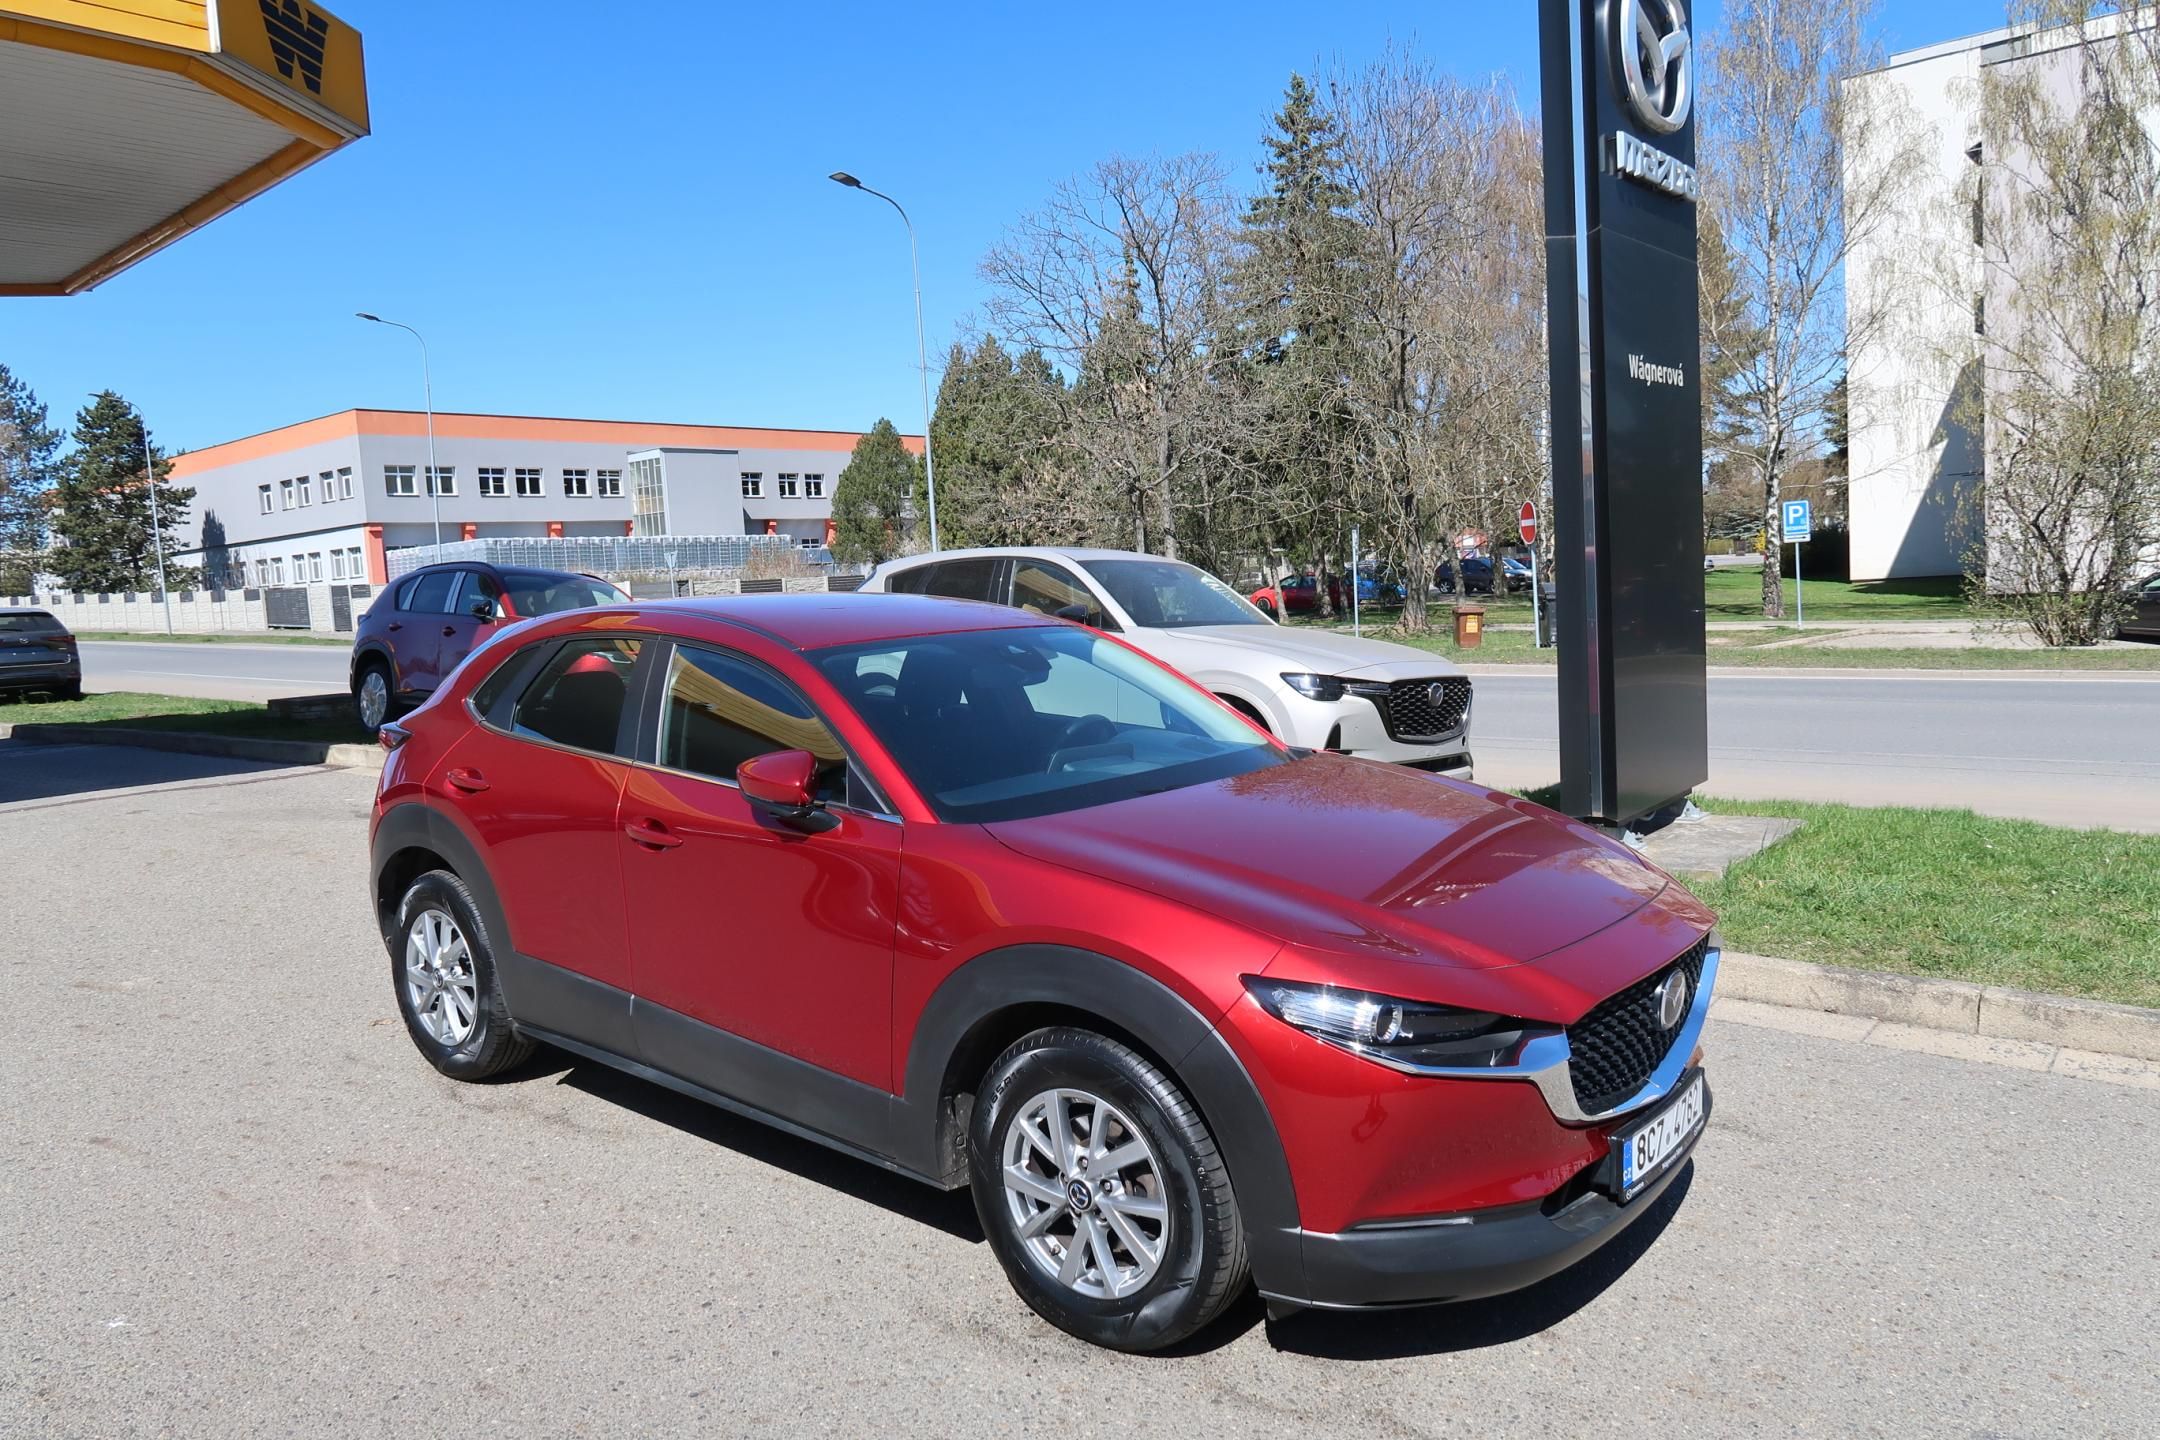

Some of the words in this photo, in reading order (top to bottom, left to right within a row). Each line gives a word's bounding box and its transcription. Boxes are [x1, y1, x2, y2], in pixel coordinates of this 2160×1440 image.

[1628, 353, 1684, 387] Wágnerová
[1788, 505, 1804, 525] P
[1637, 1118, 1664, 1171] 8C7
[1623, 1167, 1632, 1181] CZ
